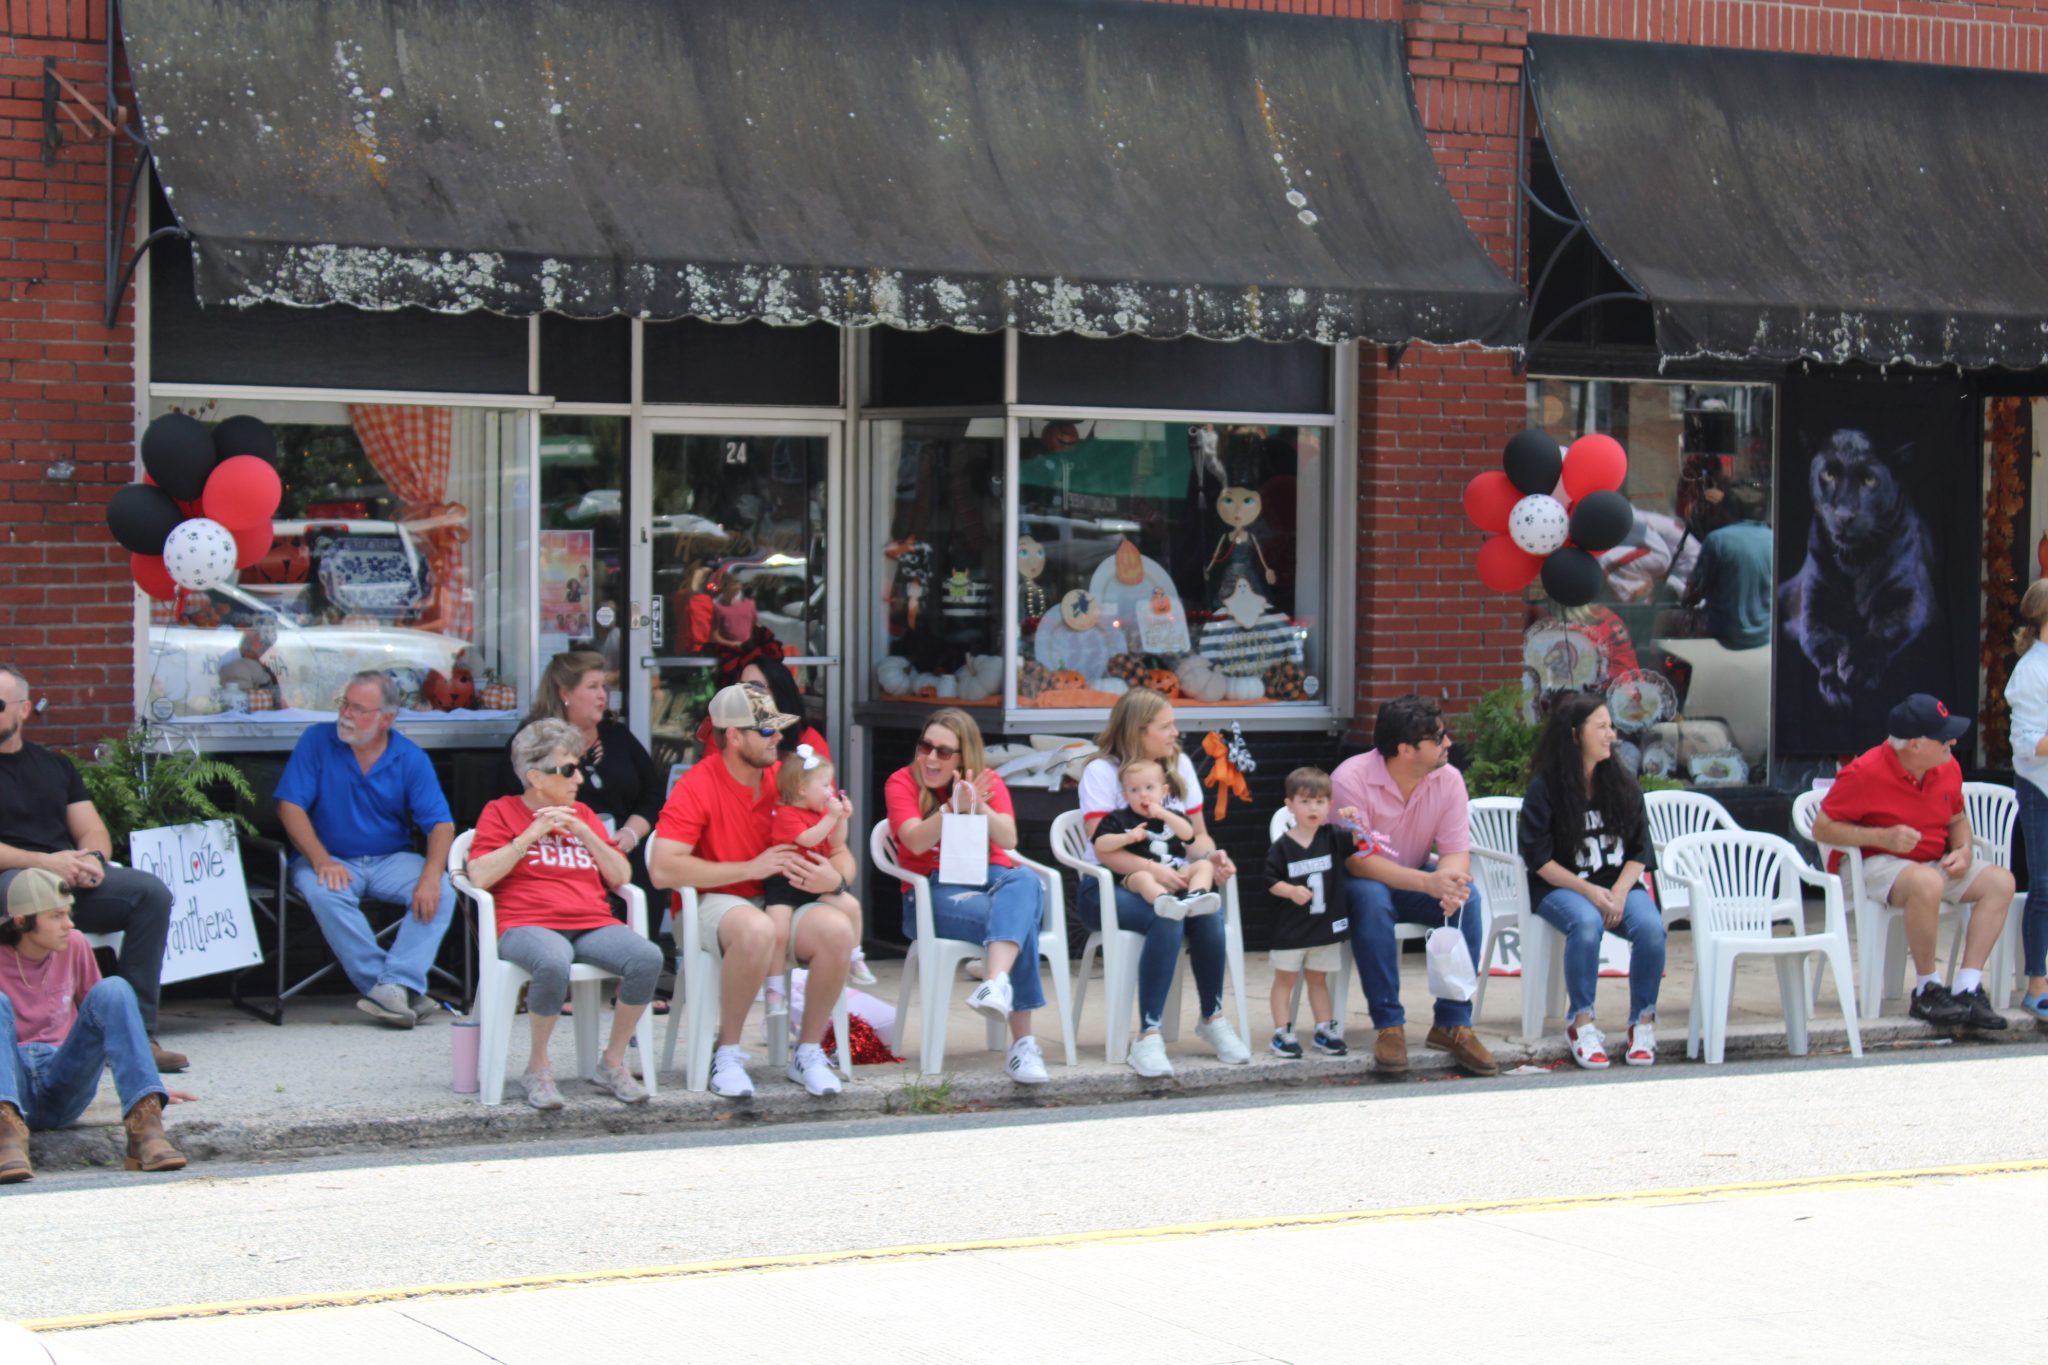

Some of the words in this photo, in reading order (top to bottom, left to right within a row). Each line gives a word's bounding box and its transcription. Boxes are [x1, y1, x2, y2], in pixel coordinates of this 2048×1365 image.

[726, 441, 747, 464] 24
[652, 600, 661, 642] PULL
[178, 834, 225, 884] Love
[1306, 872, 1326, 914] 1
[164, 896, 238, 960] anthers
